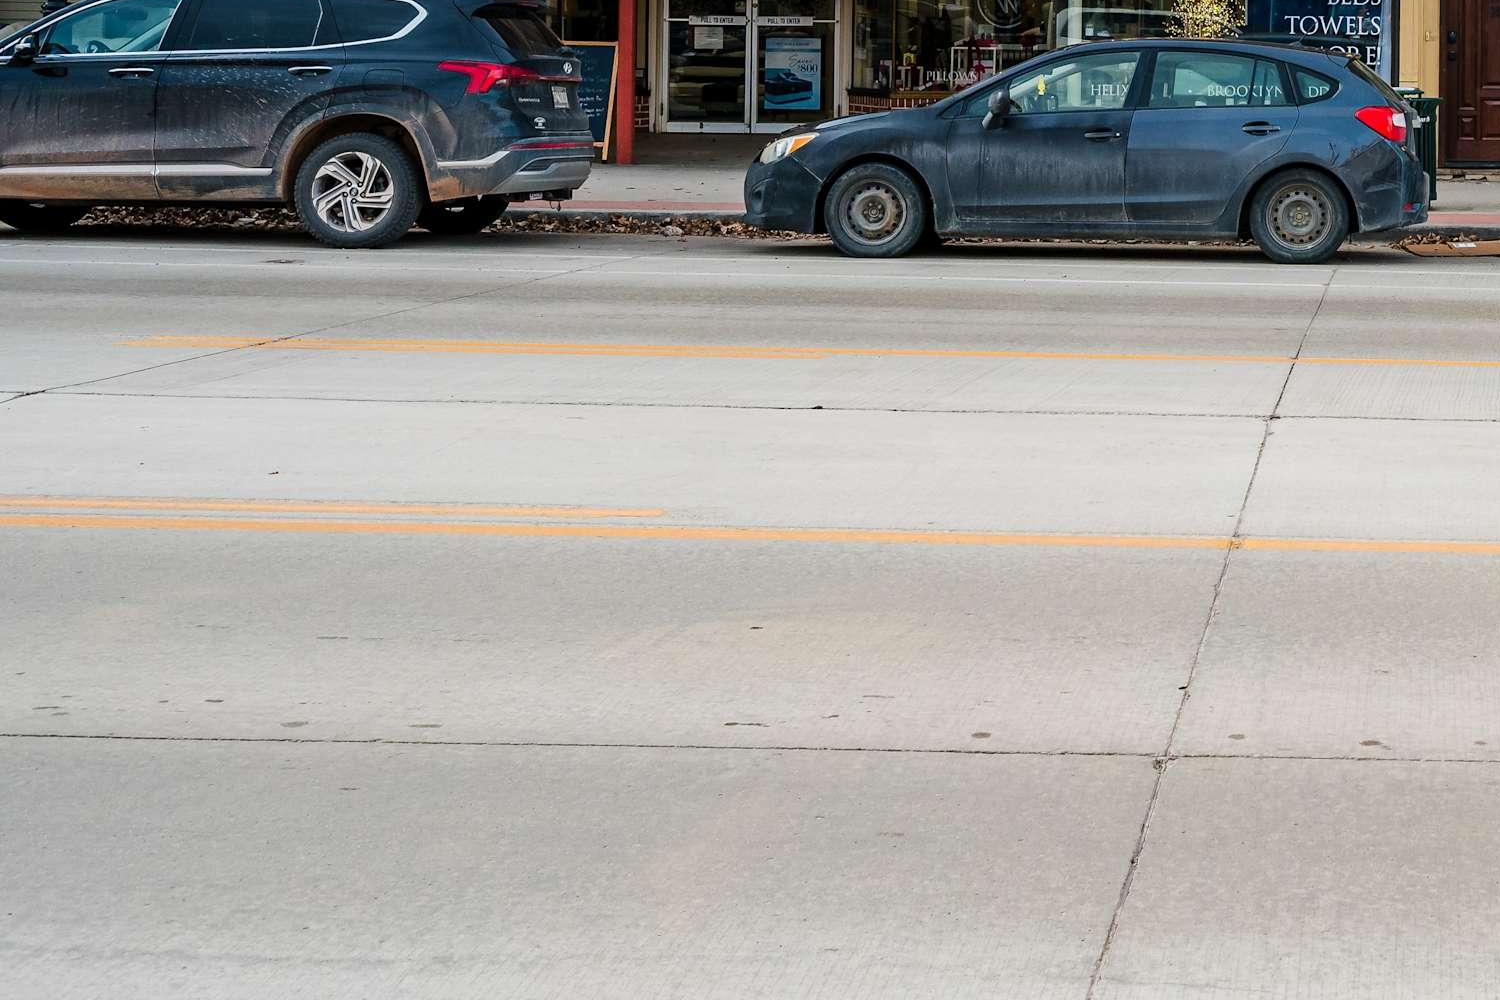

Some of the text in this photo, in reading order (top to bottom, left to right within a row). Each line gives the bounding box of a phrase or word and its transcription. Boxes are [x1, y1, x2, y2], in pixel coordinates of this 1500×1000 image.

[1284, 15, 1382, 35] TOWELS
[926, 70, 978, 81] PILLOWS
[1091, 84, 1129, 97] HELIX
